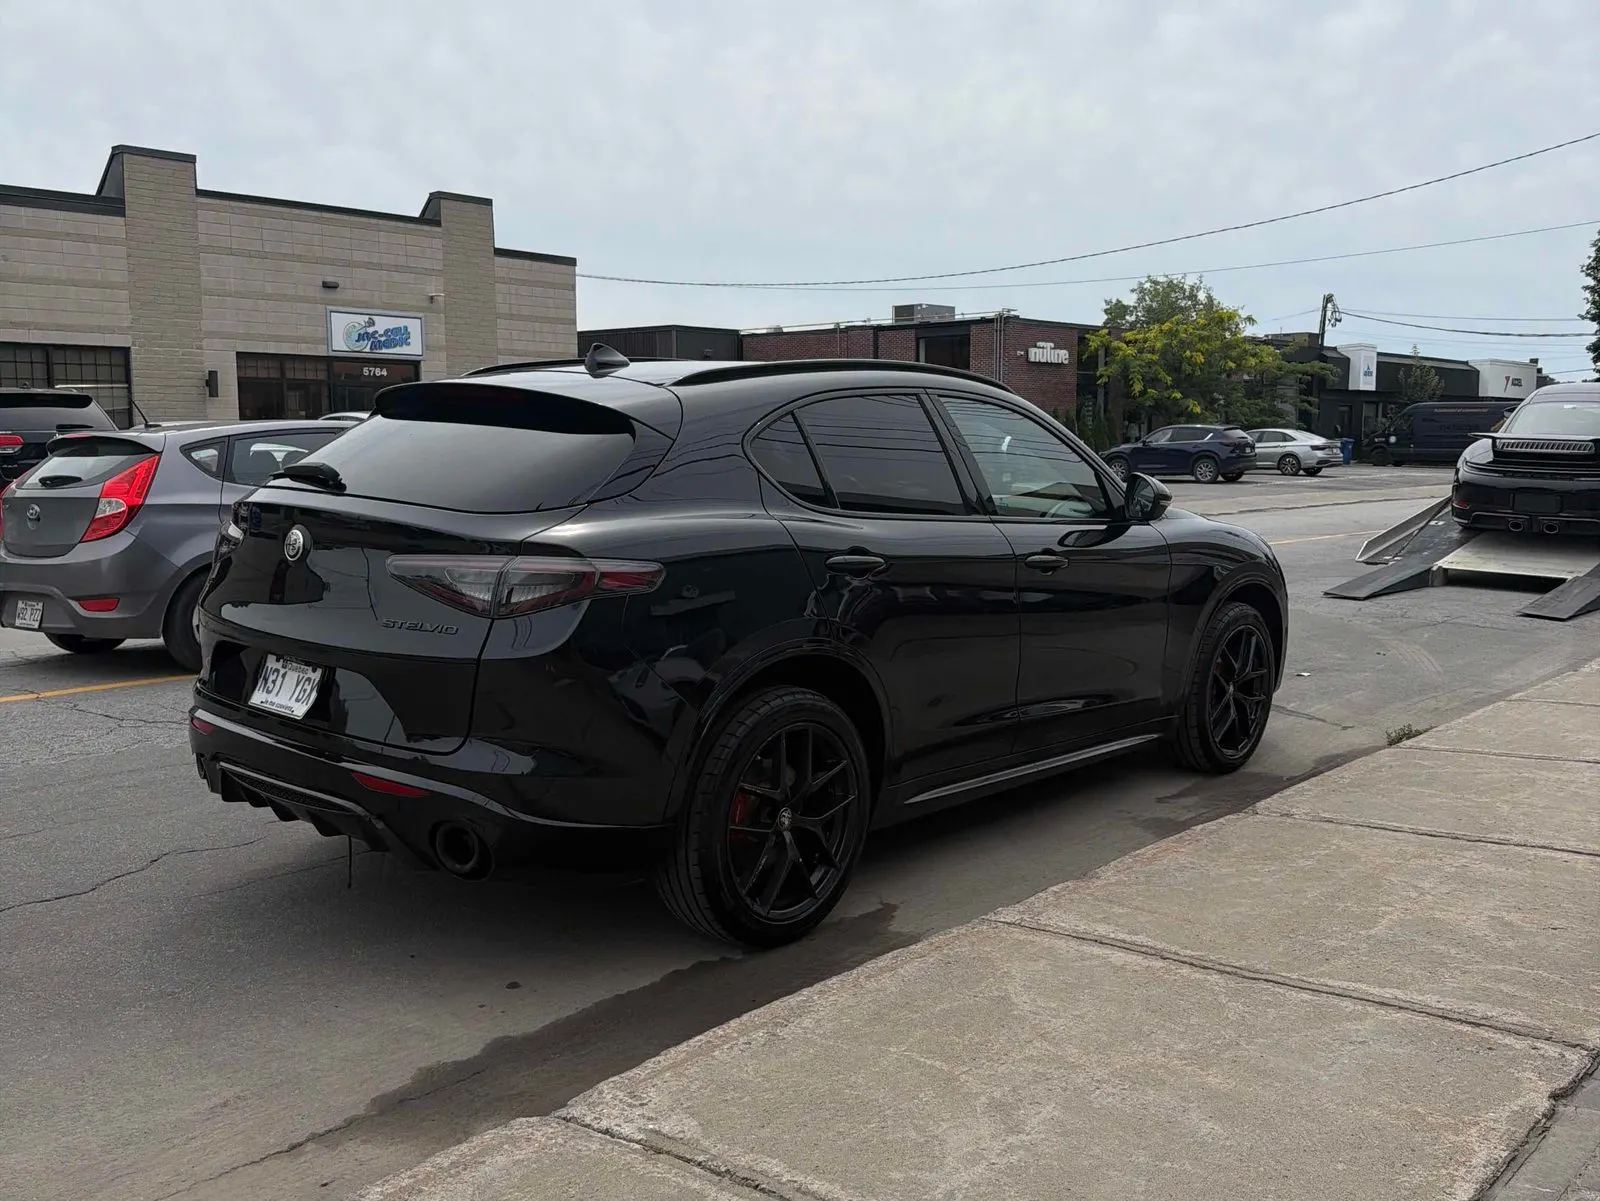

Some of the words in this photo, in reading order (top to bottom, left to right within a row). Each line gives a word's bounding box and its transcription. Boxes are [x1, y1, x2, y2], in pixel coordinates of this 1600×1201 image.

[363, 367, 388, 377] 5764
[382, 619, 460, 635] STELVIO
[258, 665, 288, 697] N31
